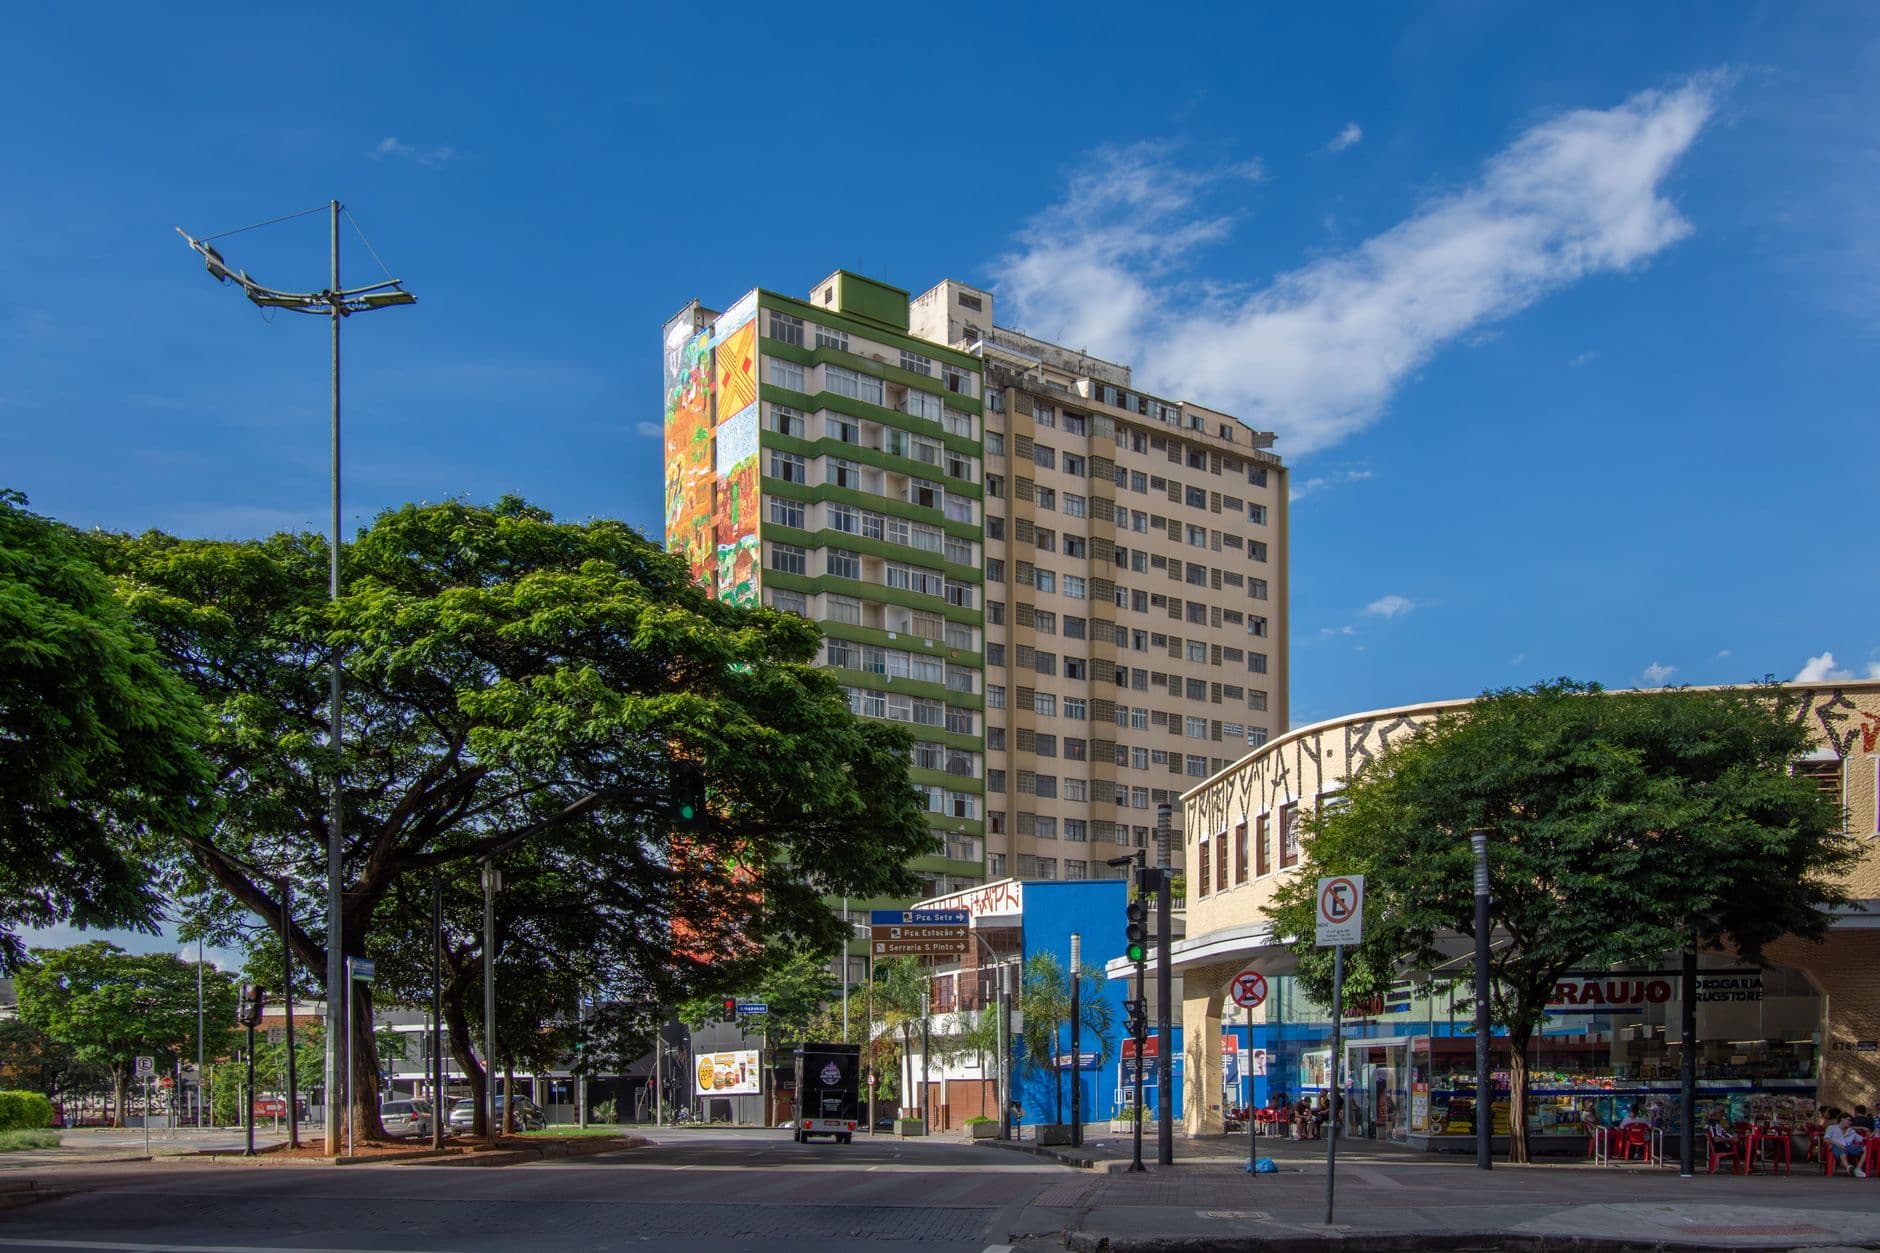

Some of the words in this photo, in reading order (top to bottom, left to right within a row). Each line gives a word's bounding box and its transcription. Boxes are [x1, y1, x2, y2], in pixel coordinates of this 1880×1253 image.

[934, 913, 953, 921] Sete
[889, 943, 922, 952] Serraria
[924, 943, 932, 951] S.
[933, 943, 954, 951] Pinto
[1696, 992, 1764, 1002] RUGSTORE
